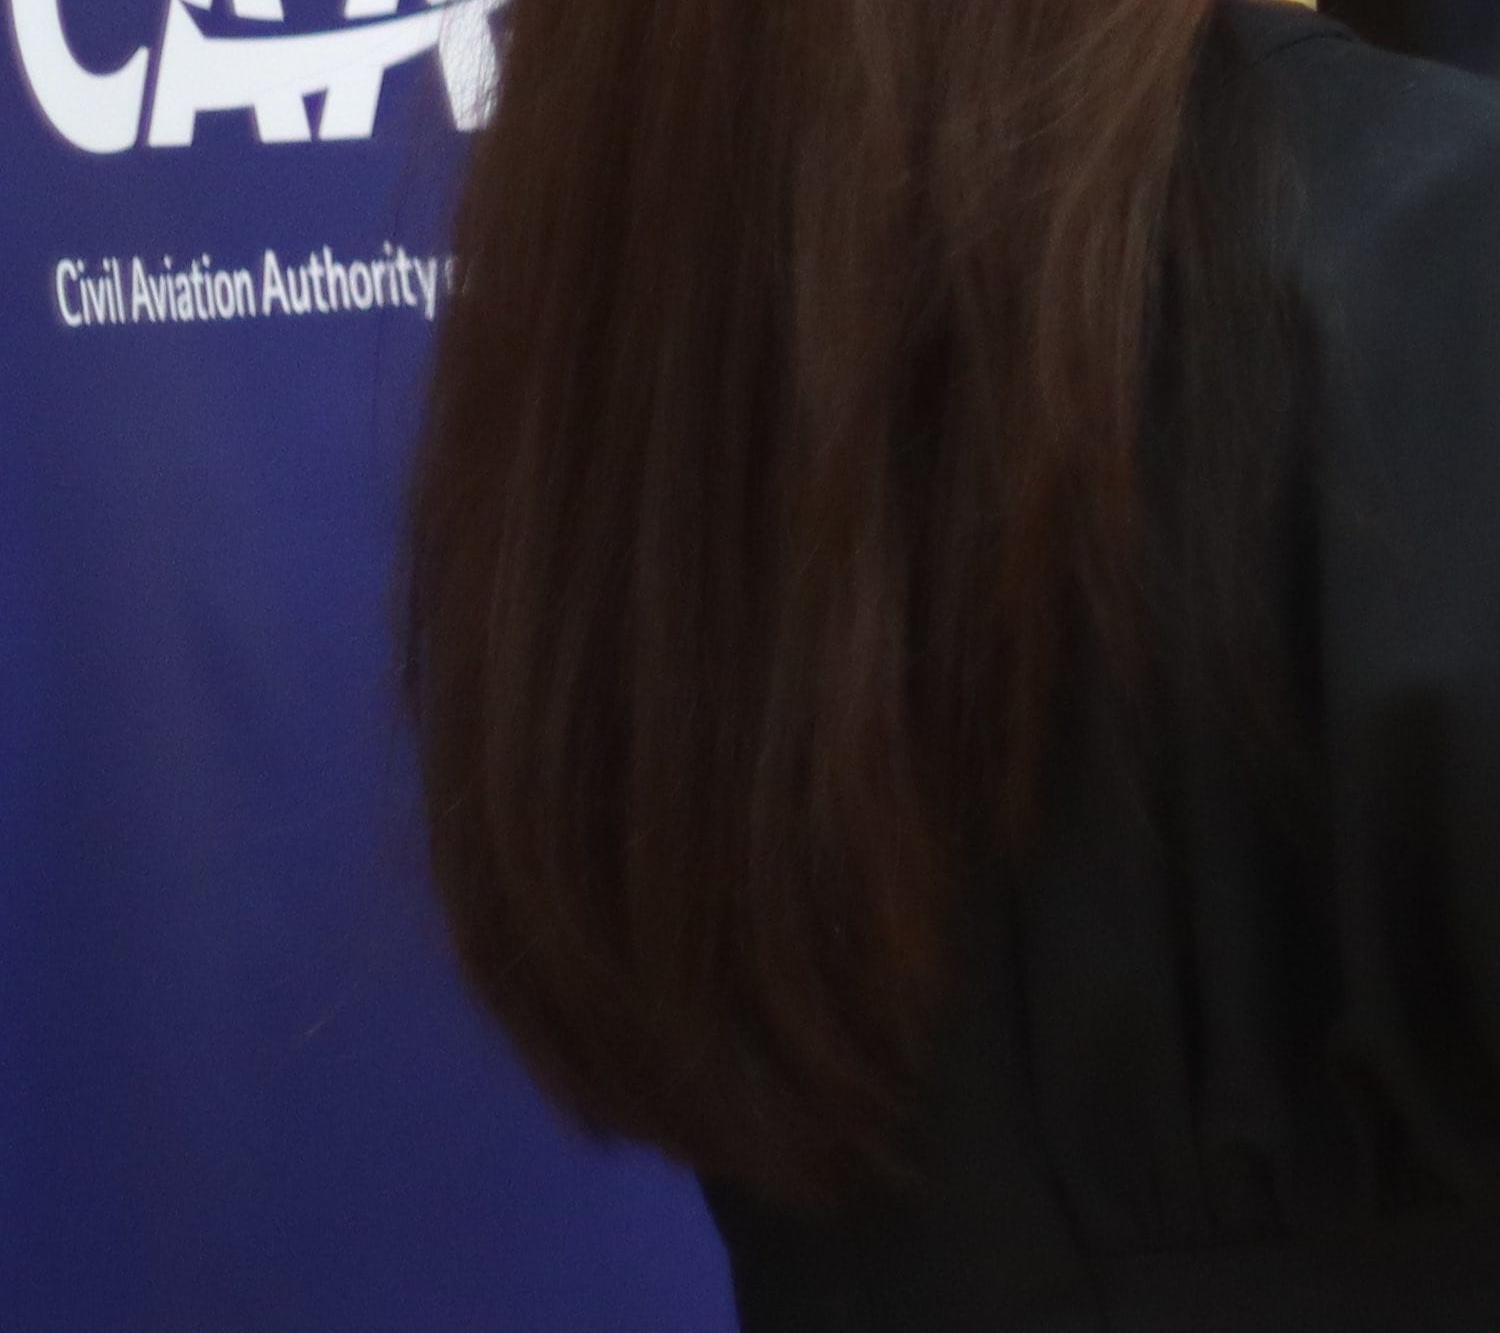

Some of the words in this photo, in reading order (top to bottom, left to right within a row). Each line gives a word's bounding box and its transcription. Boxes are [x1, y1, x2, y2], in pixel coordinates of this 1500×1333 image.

[54, 255, 127, 327] Civil
[130, 253, 257, 325] Aviation
[261, 241, 439, 322] Authority
